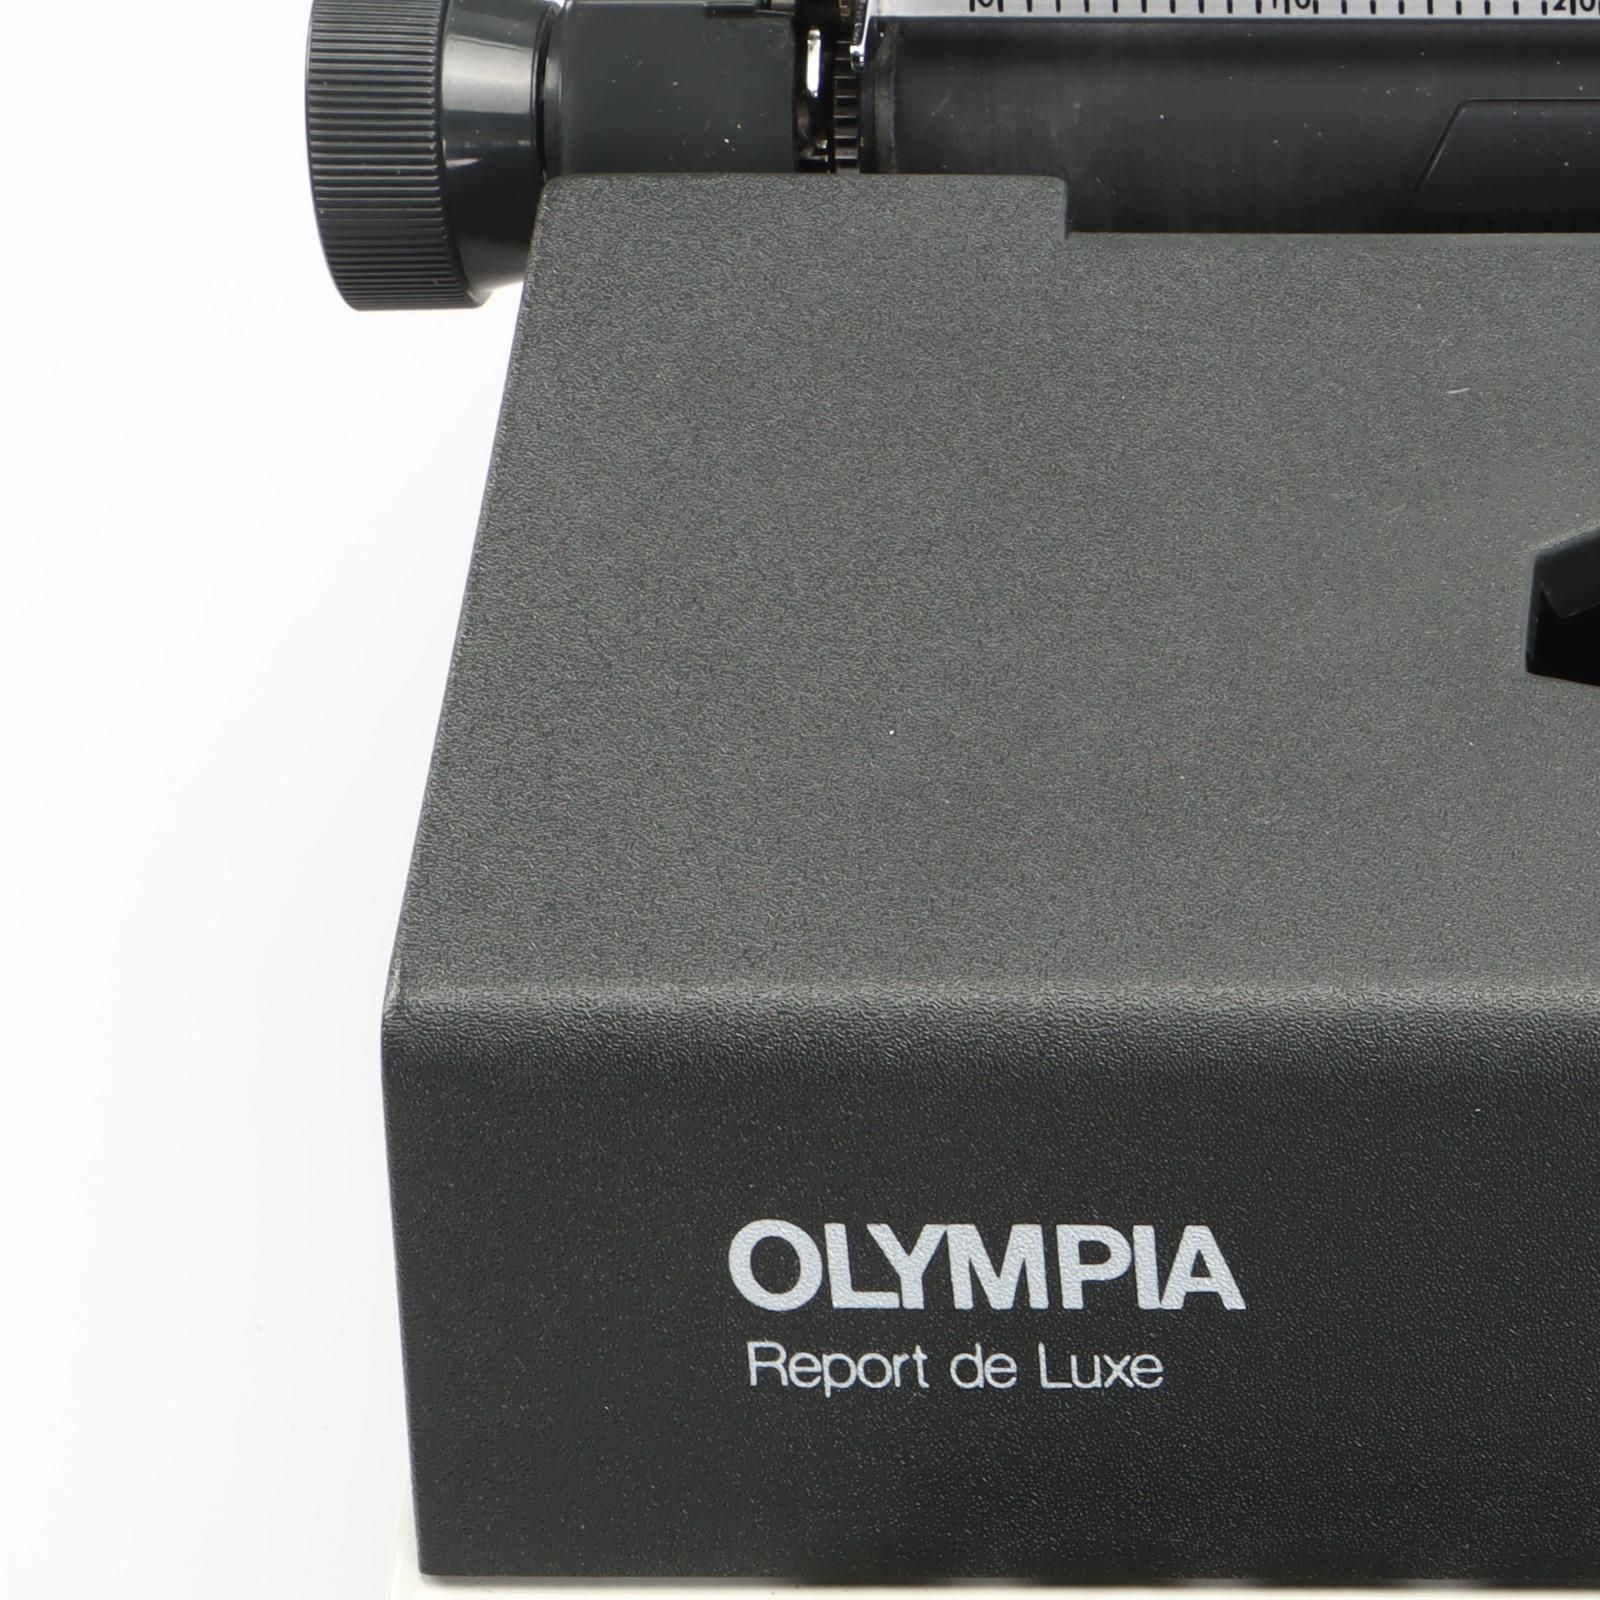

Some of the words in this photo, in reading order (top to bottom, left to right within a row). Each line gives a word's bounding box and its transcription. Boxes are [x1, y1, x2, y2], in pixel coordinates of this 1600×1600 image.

[728, 1218, 1247, 1312] OLYMPIA
[746, 1339, 930, 1399] Report
[949, 1342, 1018, 1389] de
[1038, 1342, 1164, 1389] Luxe
